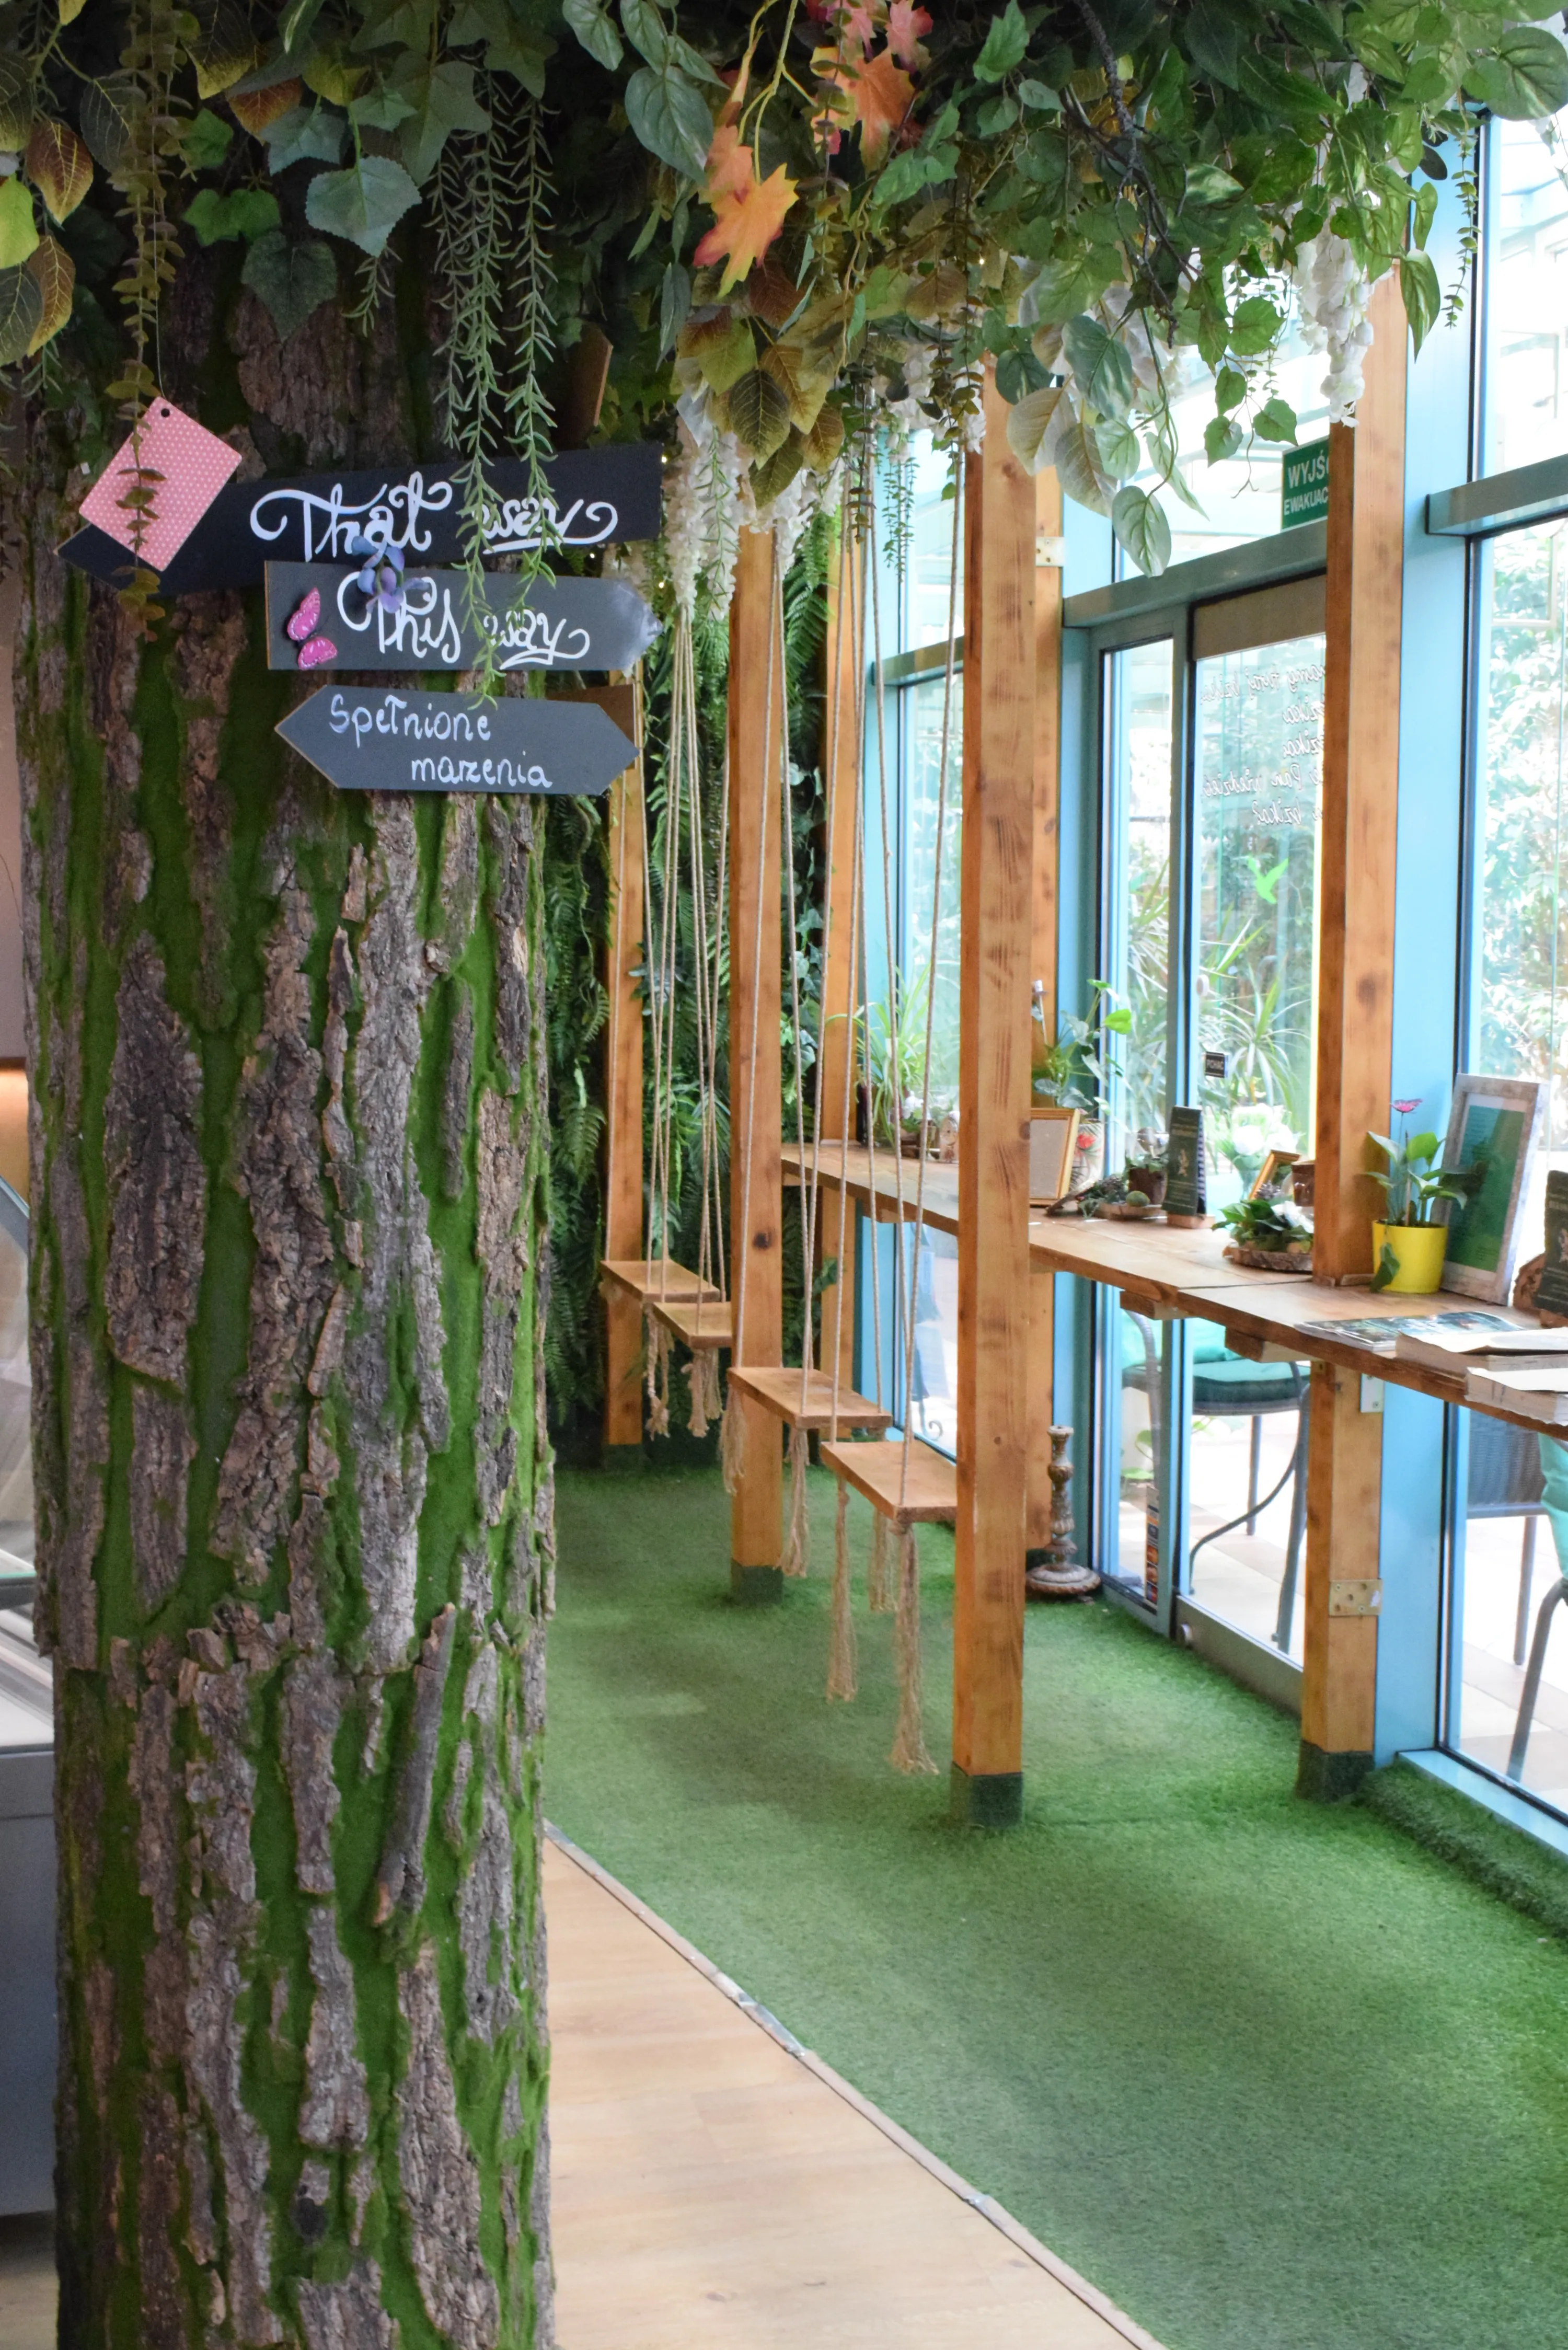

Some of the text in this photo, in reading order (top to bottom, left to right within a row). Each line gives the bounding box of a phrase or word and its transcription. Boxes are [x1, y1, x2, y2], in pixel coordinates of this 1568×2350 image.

[250, 471, 453, 562] That
[337, 571, 590, 670] This way
[411, 751, 553, 788] marzenia
